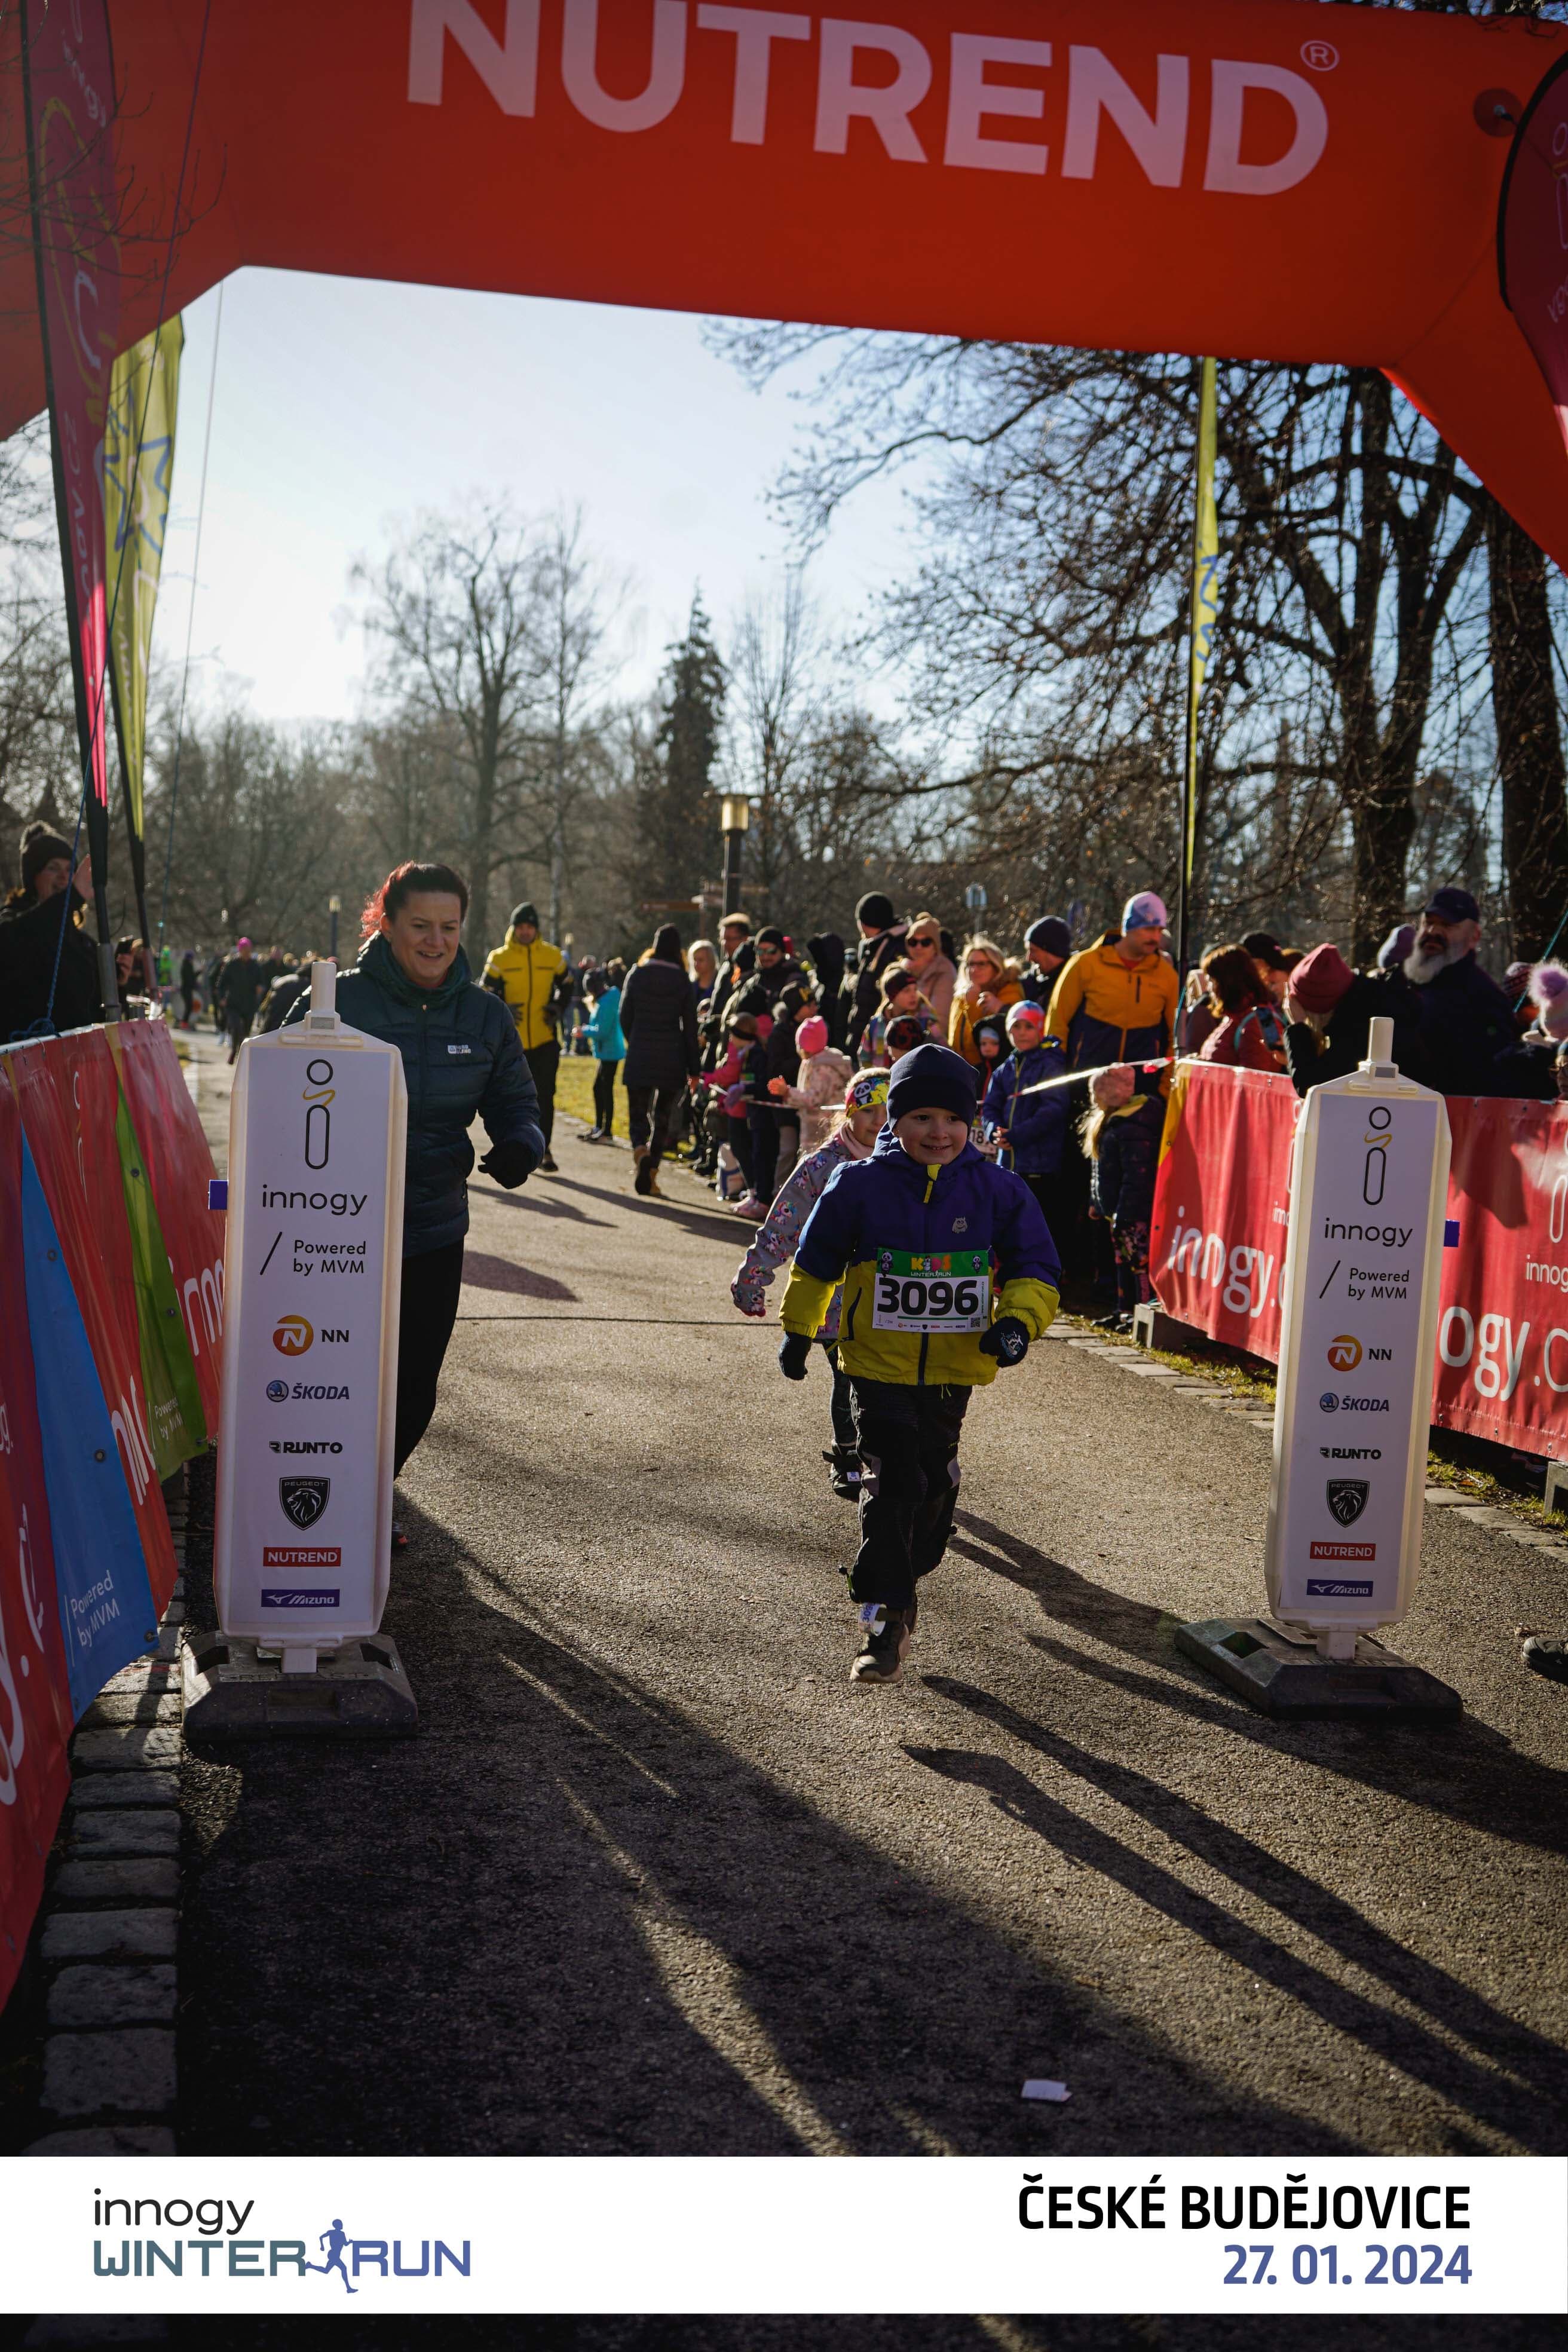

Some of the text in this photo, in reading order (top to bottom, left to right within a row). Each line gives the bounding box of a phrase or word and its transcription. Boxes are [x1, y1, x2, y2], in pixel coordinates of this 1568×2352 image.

[408, 0, 1328, 195] NUTREND
[262, 1184, 368, 1216] innogy
[1324, 1217, 1413, 1248] innogy
[294, 1239, 366, 1255] Powered
[293, 1258, 364, 1277] by MVM
[1349, 1267, 1410, 1282] Powered
[877, 1278, 979, 1316] 3096
[1348, 1284, 1407, 1301] by MVM
[321, 1329, 350, 1343] NN
[1368, 1348, 1392, 1361] NN
[291, 1382, 350, 1400] ŠKODA
[1340, 1395, 1389, 1412] ŠKODA
[283, 1441, 343, 1454] RUNTO
[1331, 1448, 1382, 1460] RUNTO
[268, 1552, 338, 1563] NUTREND
[1314, 1545, 1373, 1557] NUTREND
[70, 1569, 114, 1620] Powered
[76, 1598, 121, 1647] by MVM
